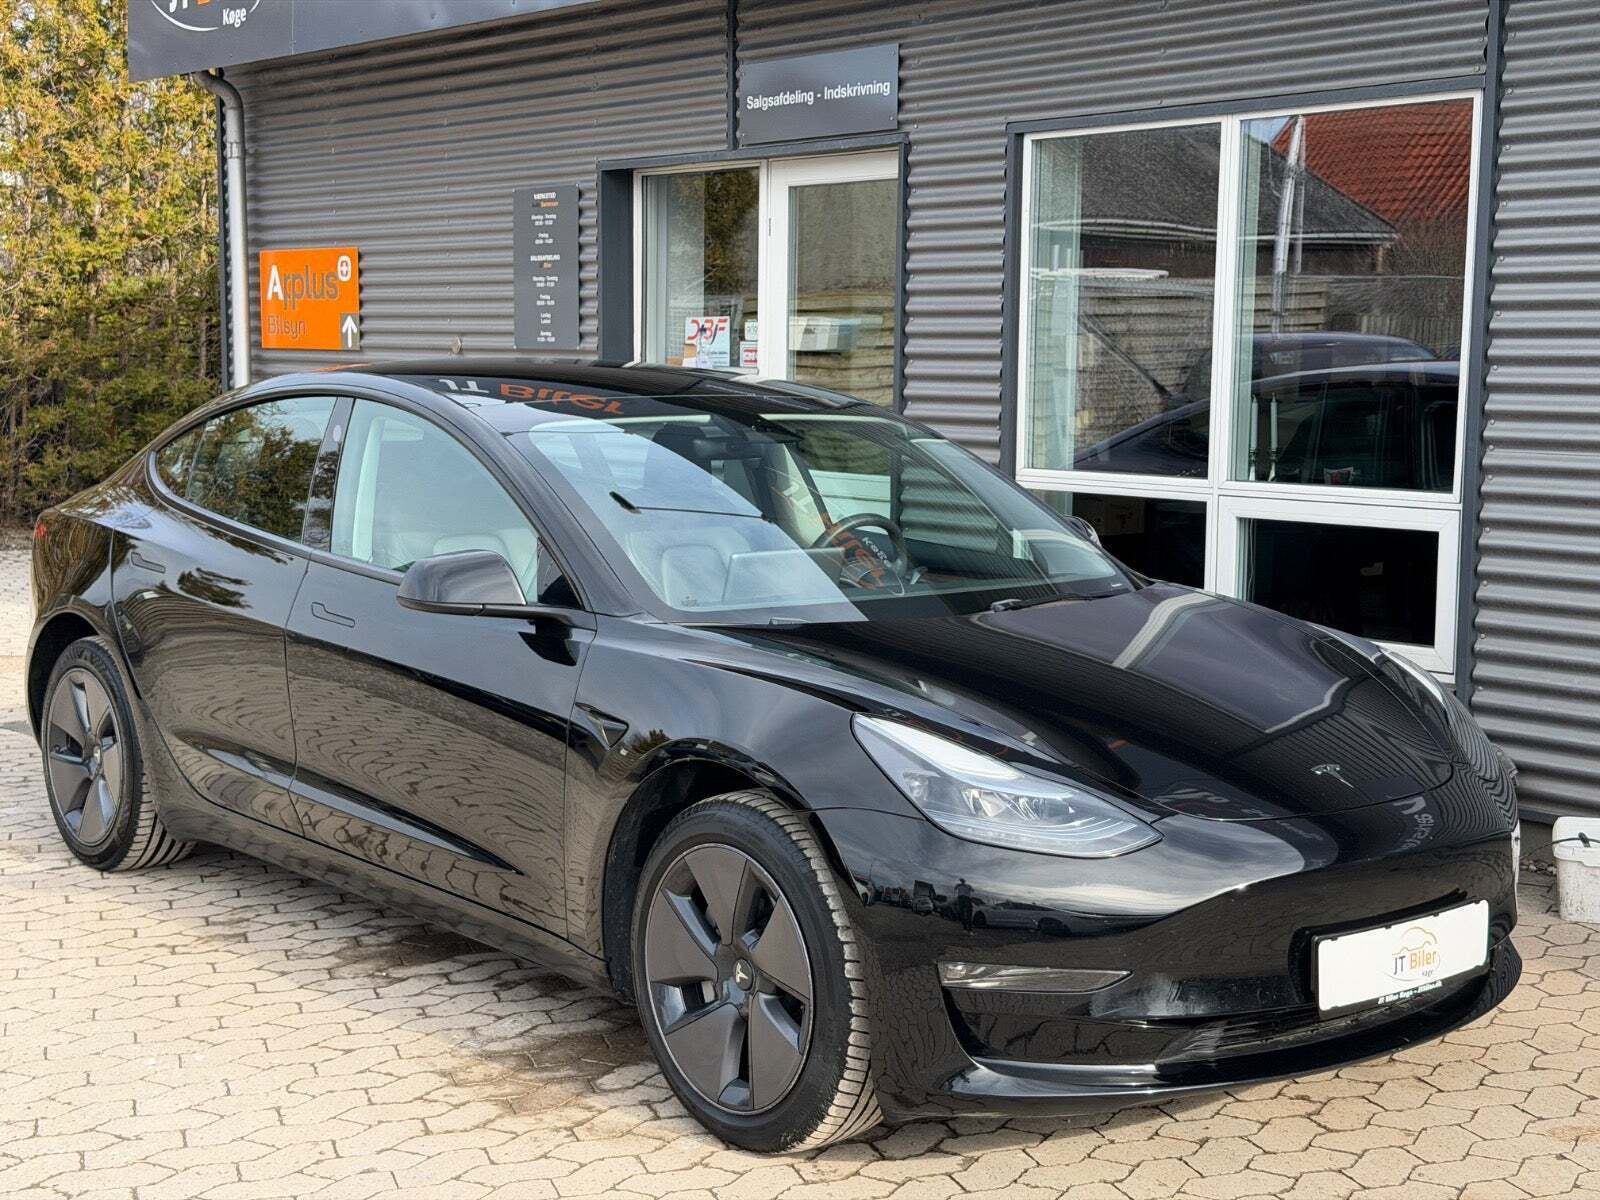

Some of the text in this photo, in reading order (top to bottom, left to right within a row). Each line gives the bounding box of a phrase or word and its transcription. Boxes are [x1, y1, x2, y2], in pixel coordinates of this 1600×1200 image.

[222, 7, 247, 28] Køge
[746, 89, 814, 111] Salgsafdeling
[824, 80, 891, 101] Indskrivning
[1393, 950, 1437, 975] JT Biler
